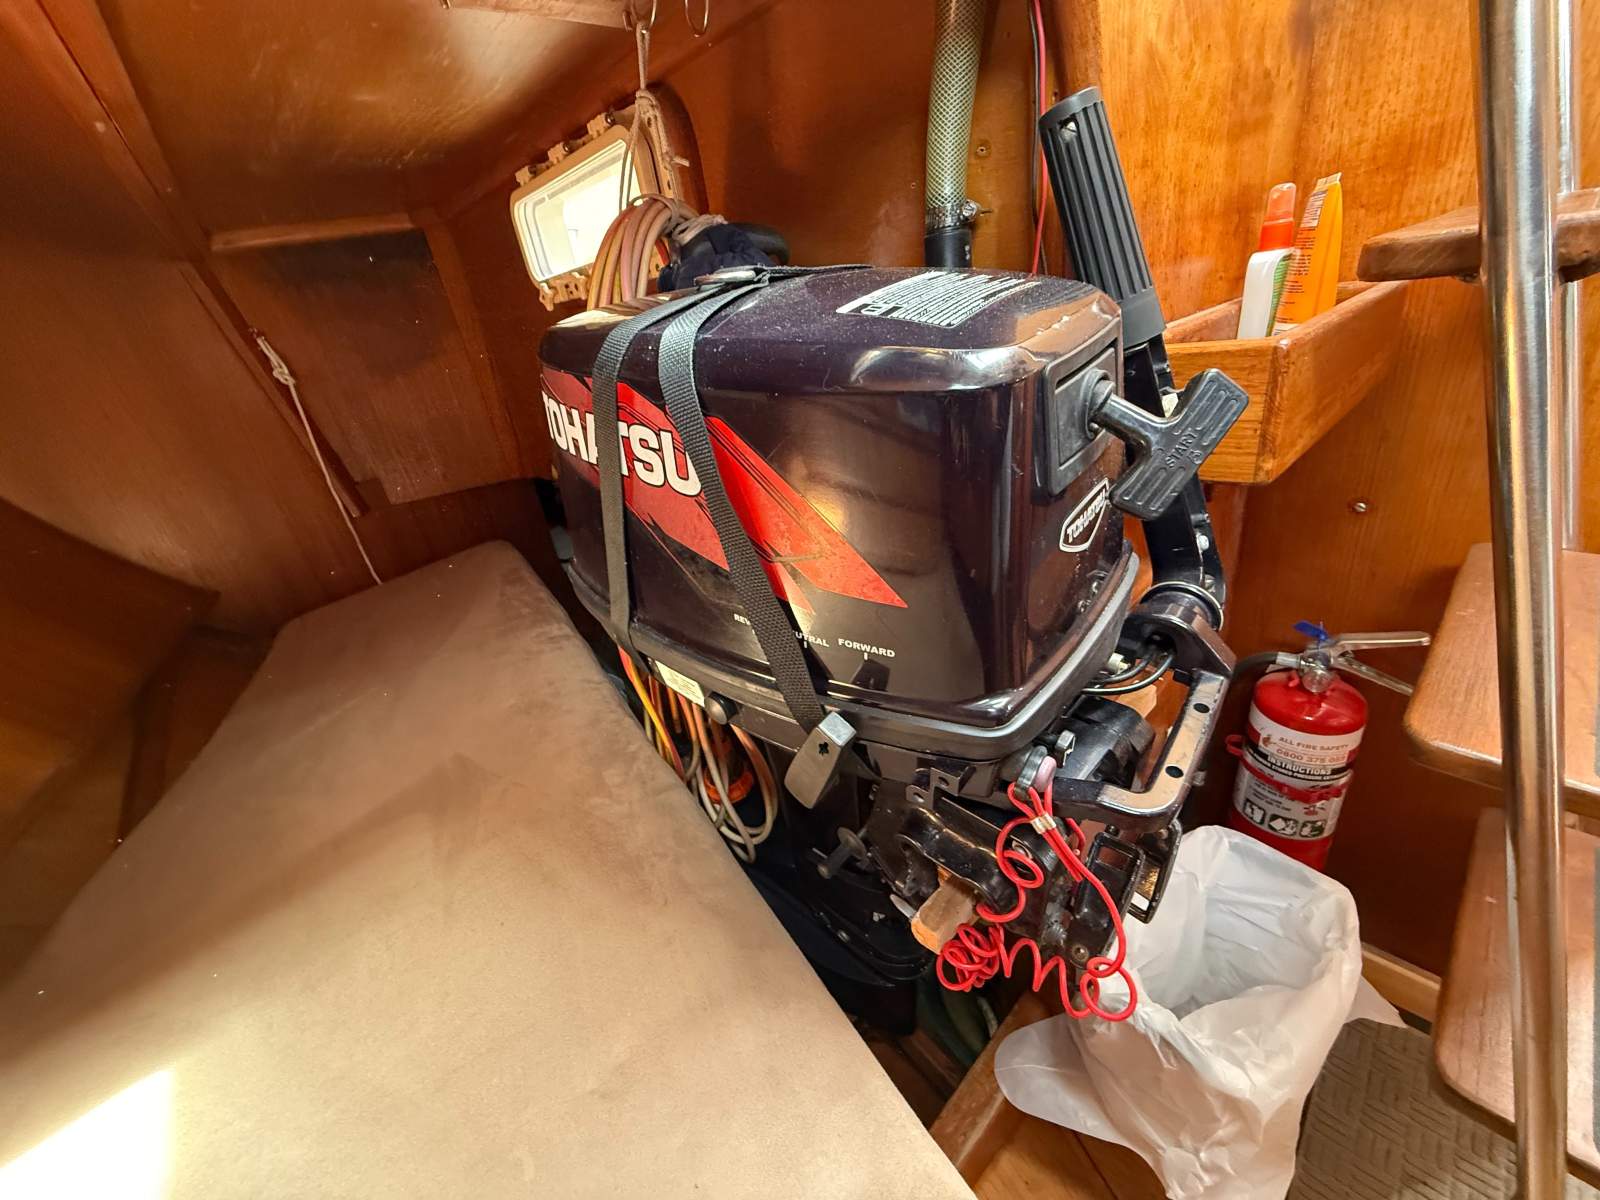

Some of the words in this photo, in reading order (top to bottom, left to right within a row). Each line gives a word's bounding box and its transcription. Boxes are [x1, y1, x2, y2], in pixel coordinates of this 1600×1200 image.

[838, 638, 895, 658] FORWARD
[1278, 736, 1294, 746] ALL
[1296, 741, 1317, 751] FIRE
[1319, 743, 1349, 751] SAFETY
[1276, 748, 1303, 761] 0800
[1267, 754, 1331, 775] INSTRUCTIONS
